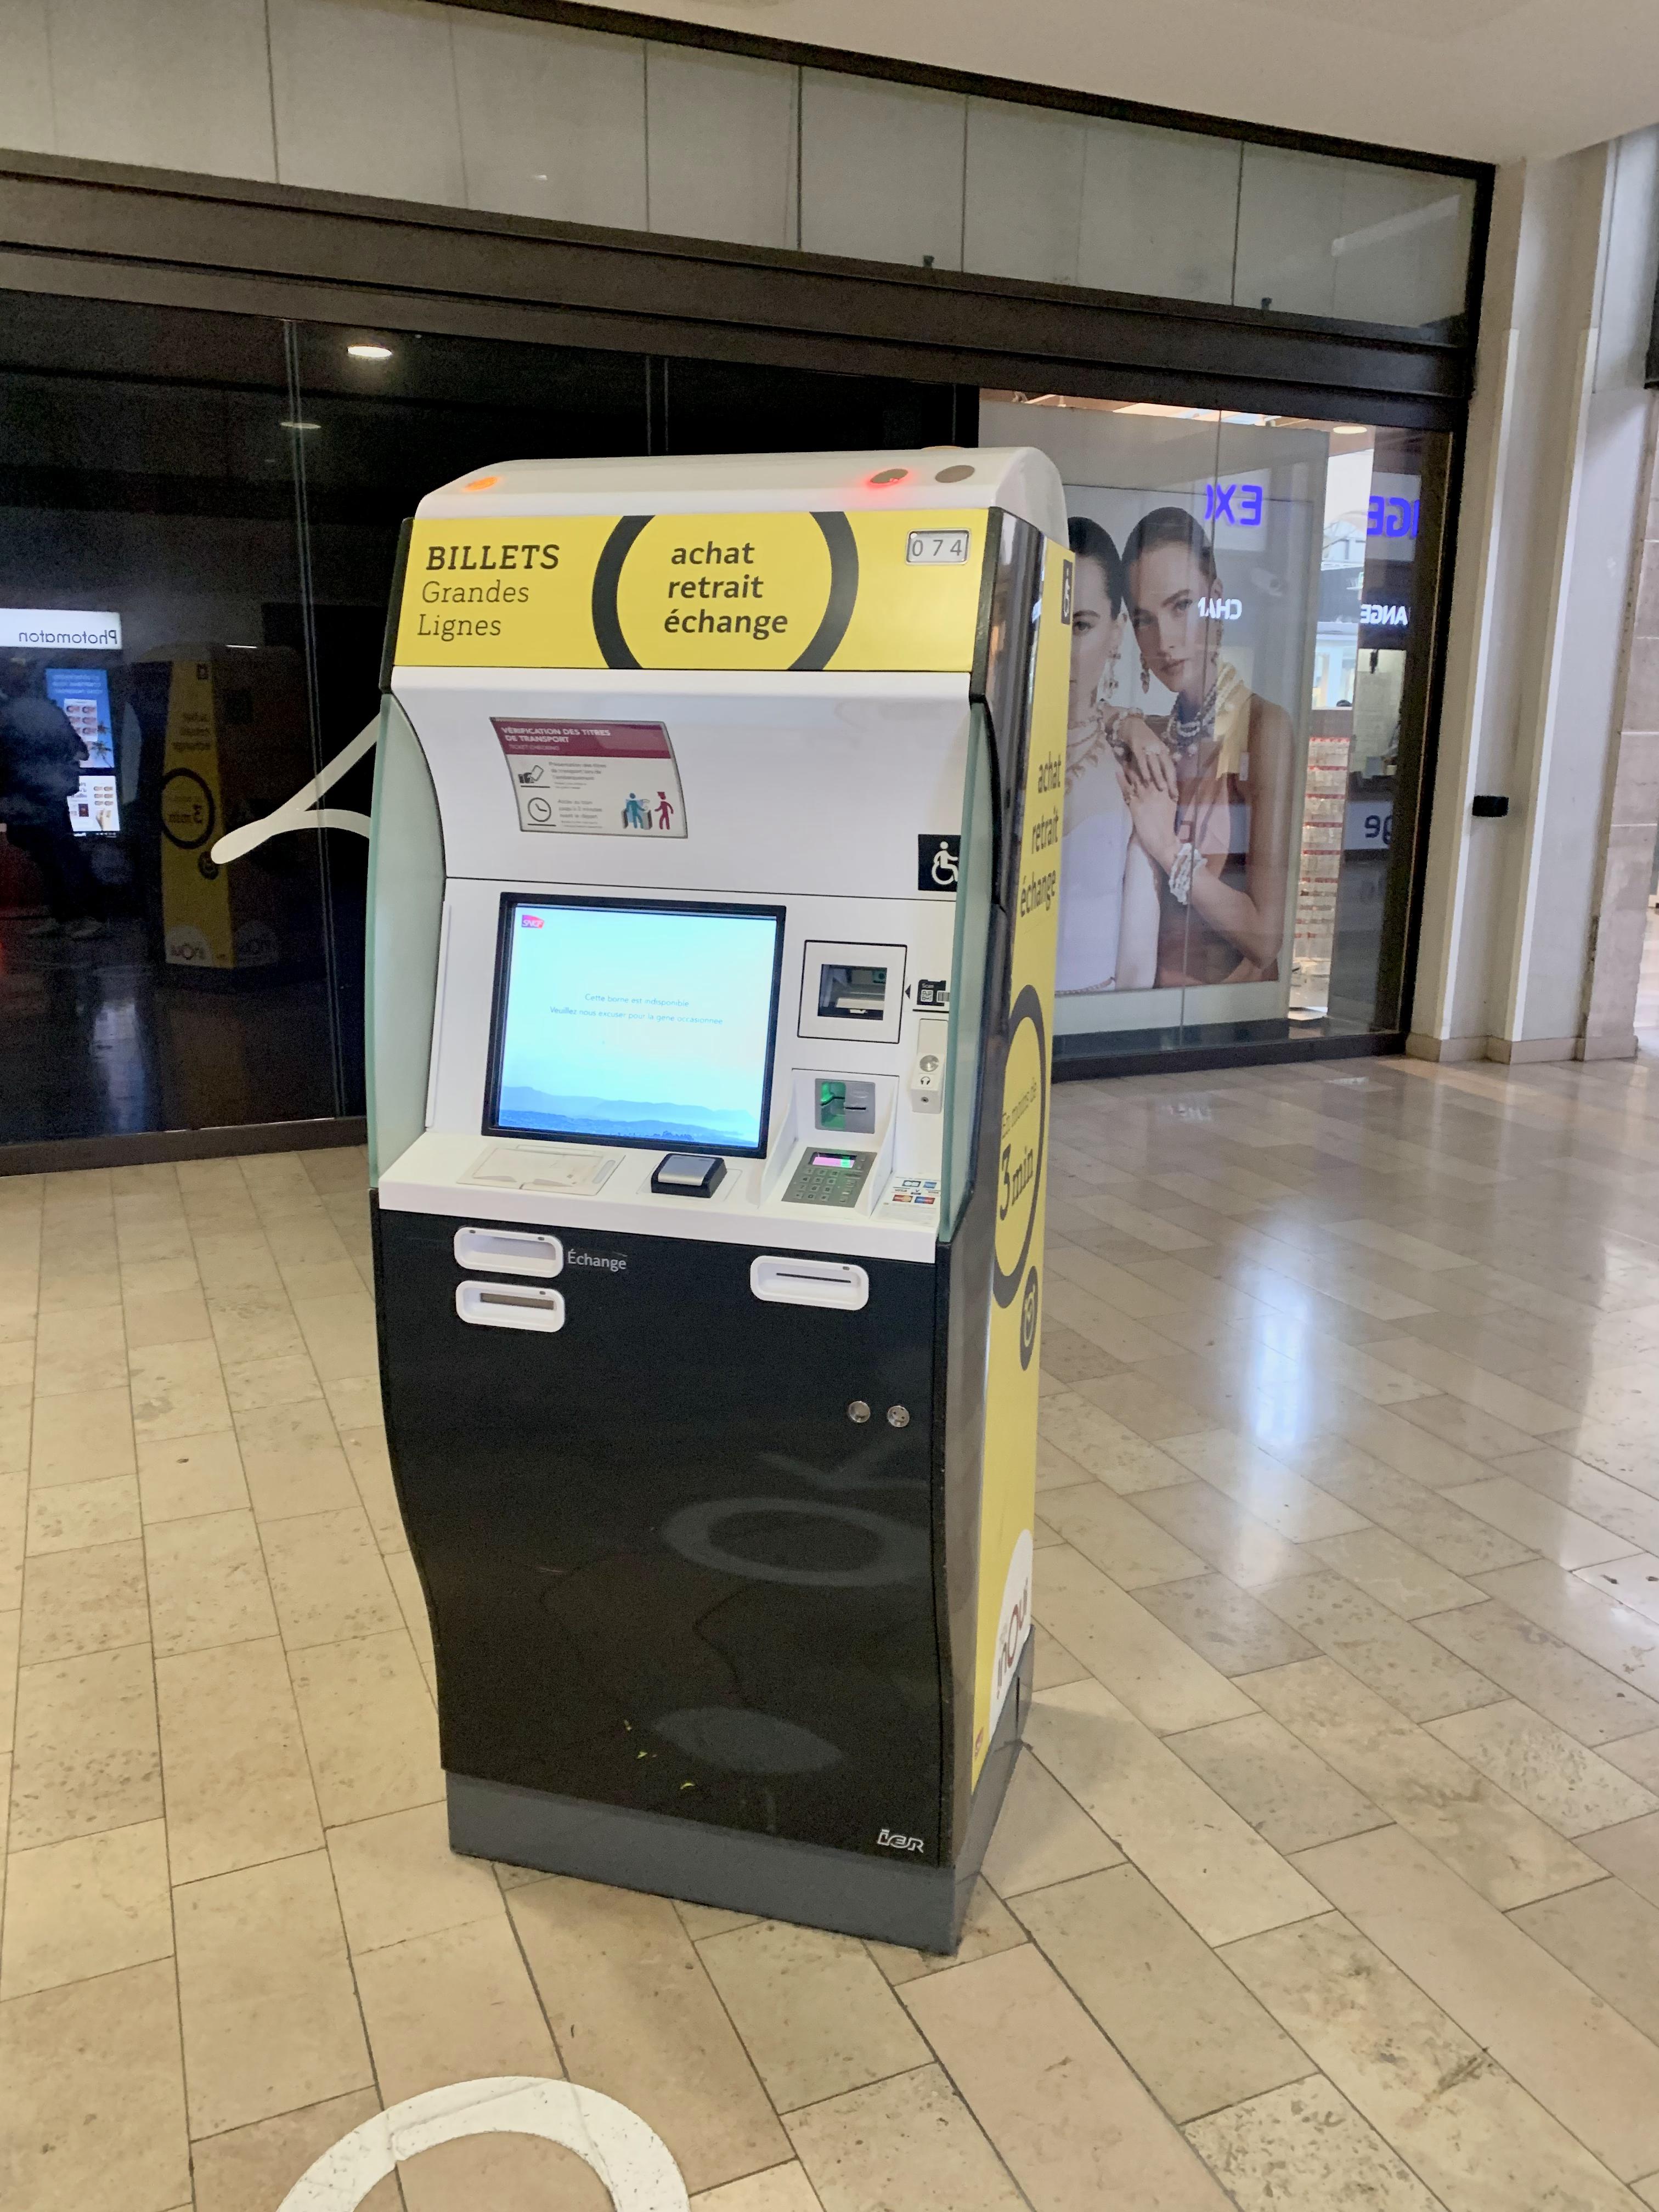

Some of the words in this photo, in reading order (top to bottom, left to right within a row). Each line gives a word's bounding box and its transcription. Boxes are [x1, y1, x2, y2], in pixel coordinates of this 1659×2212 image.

[426, 544, 560, 570] BILLETS
[671, 540, 755, 565] achat
[422, 579, 529, 603] Grandes
[668, 574, 764, 599] retrait
[417, 613, 501, 642] Lignes
[664, 608, 788, 641] échange
[1037, 751, 1062, 794] achat
[1031, 805, 1059, 855] retrait
[1020, 870, 1057, 918] échange
[522, 919, 544, 928] SNCF
[550, 1006, 577, 1015] Veuillez
[585, 993, 605, 1002] Cette
[607, 995, 629, 1003] borne
[644, 998, 690, 1007] indisponible
[1000, 1143, 1012, 1221] 3
[1011, 1145, 1034, 1206] min
[568, 1248, 627, 1272] Échange
